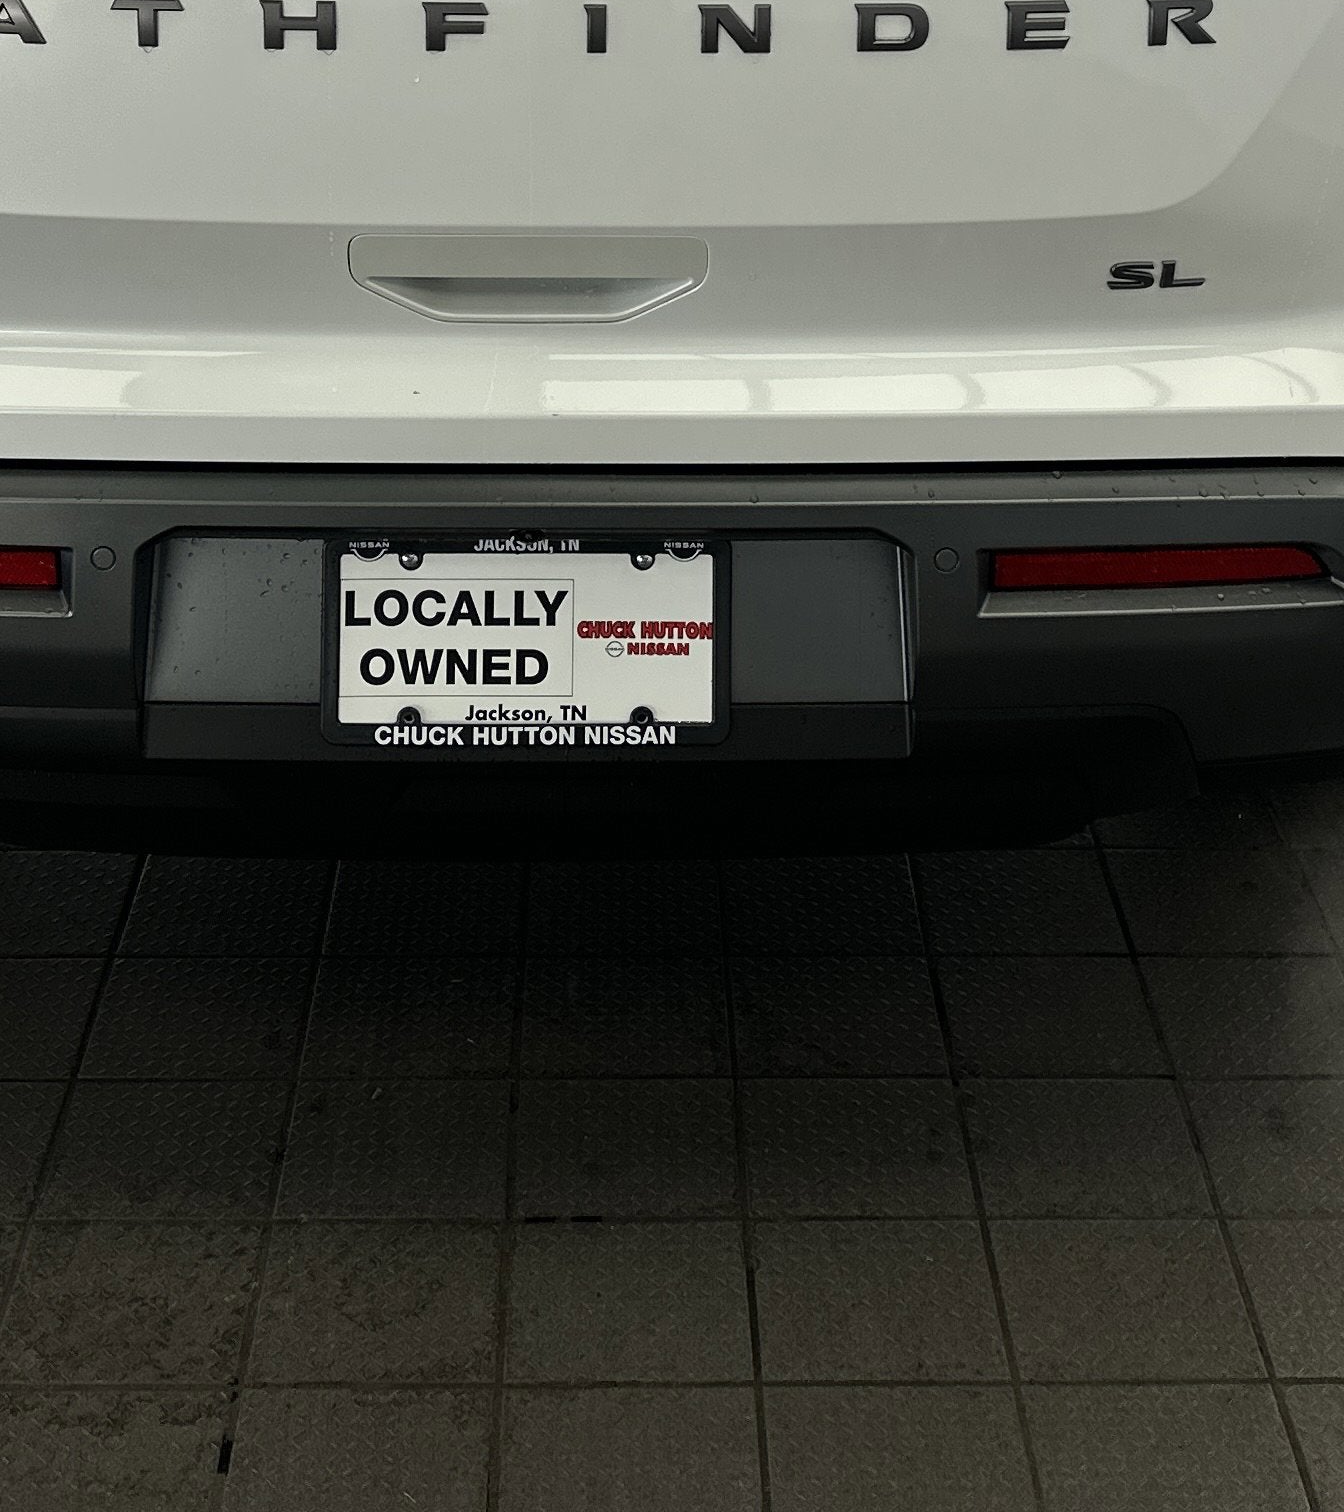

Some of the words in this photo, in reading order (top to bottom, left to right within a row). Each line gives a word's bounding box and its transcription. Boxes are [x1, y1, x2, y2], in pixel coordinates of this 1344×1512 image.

[1106, 259, 1206, 290] SL
[663, 541, 705, 549] NISSAN
[343, 589, 569, 627] LOCALLY
[576, 620, 636, 639] CHUCK
[640, 621, 713, 639] HUTTON
[626, 642, 690, 656] NISSAN
[359, 648, 549, 686] OWNED
[464, 704, 553, 723] Jackson,
[560, 704, 587, 721] TN
[373, 726, 465, 746] CHUCK
[472, 726, 576, 746] HUTTON
[584, 726, 677, 745] NISSAN
